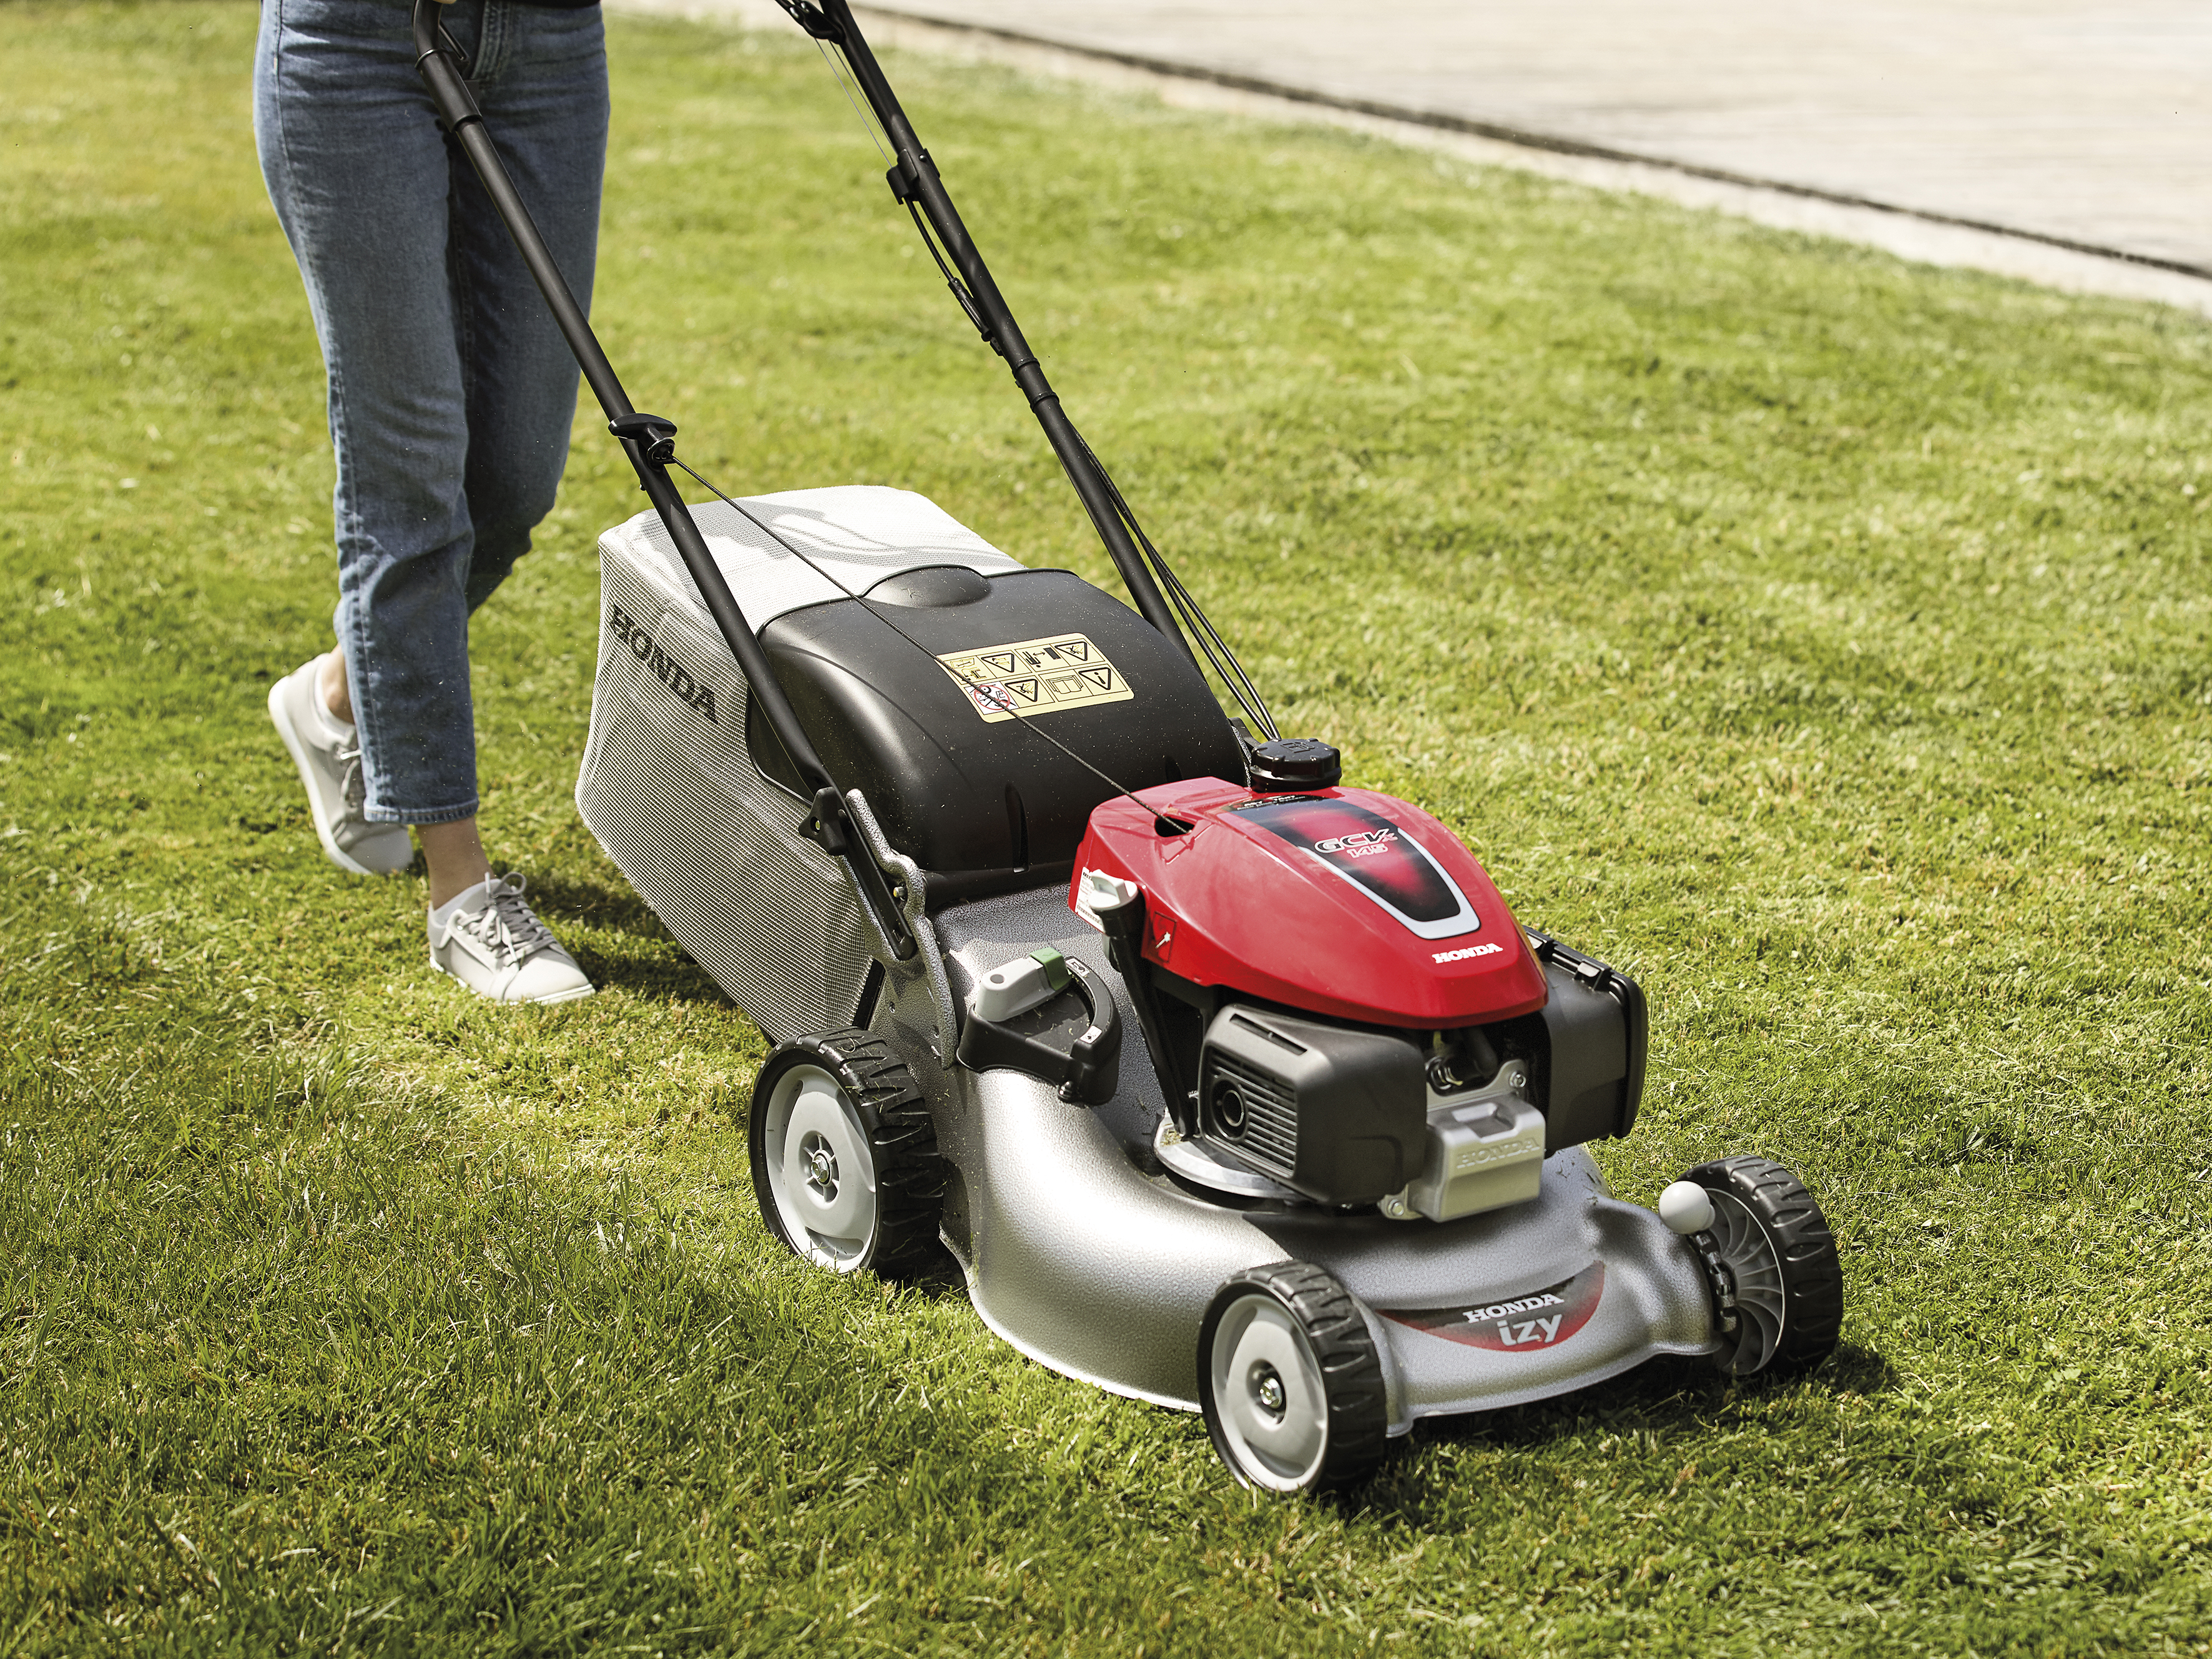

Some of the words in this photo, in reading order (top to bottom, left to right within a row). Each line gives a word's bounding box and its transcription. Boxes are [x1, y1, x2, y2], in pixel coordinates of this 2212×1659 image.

[611, 603, 718, 725] HONDA
[1346, 843, 1389, 859] 145
[1432, 943, 1503, 963] HONDA
[1457, 1138, 1540, 1169] HONDA
[1463, 1293, 1564, 1324] HONDA
[1497, 1314, 1562, 1346] izy
